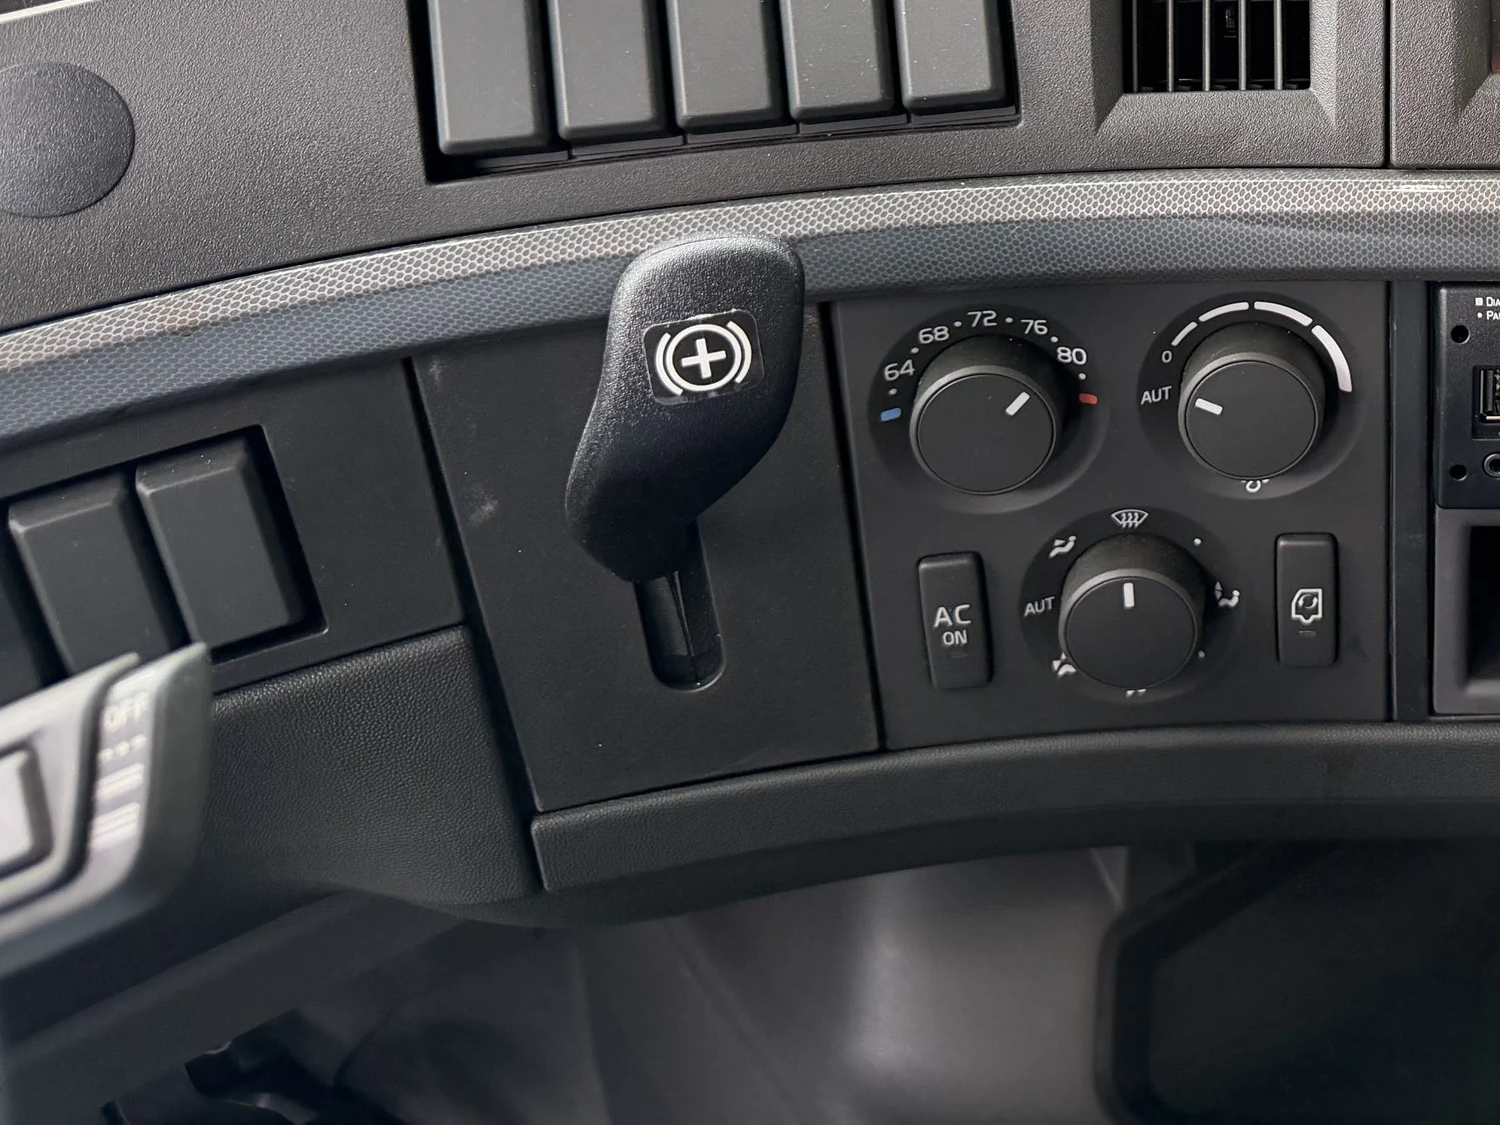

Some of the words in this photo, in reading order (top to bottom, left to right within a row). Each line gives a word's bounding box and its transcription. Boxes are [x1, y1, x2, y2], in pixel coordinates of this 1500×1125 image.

[967, 310, 998, 327] 72
[1021, 319, 1049, 336] 76
[918, 324, 950, 344] 68
[1057, 346, 1087, 366] 80
[883, 360, 915, 381] 64
[1141, 386, 1172, 406] AUT
[933, 603, 972, 628] AC
[1024, 597, 1055, 618] AUT
[943, 629, 968, 647] ON
